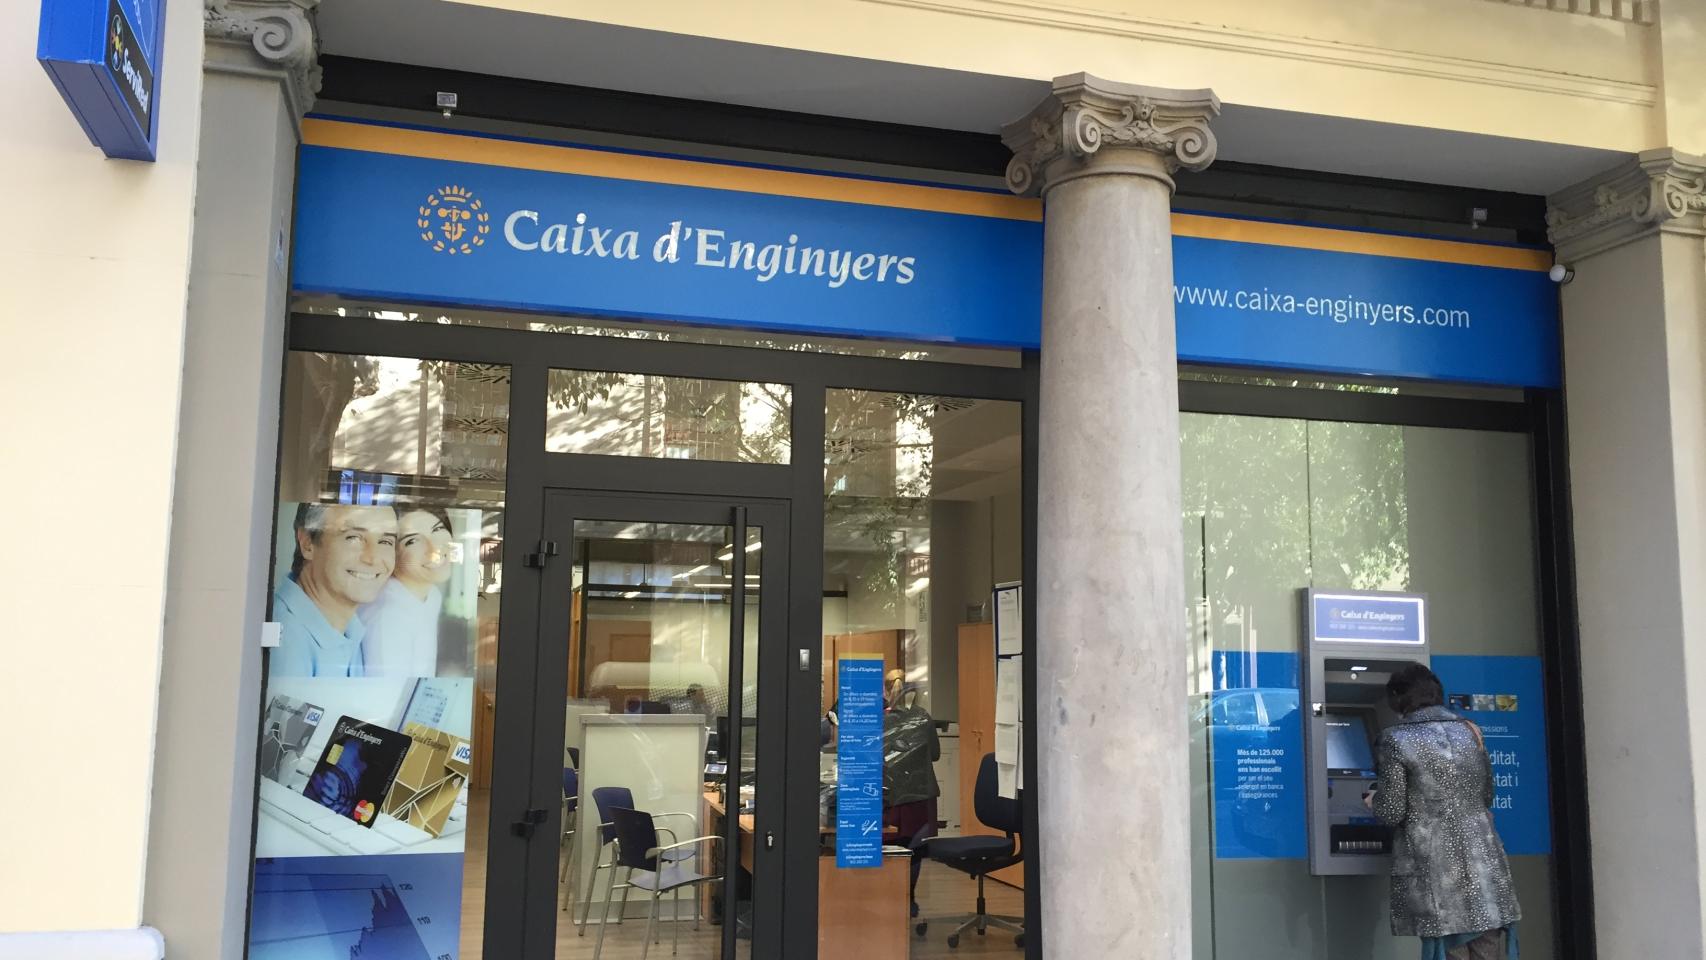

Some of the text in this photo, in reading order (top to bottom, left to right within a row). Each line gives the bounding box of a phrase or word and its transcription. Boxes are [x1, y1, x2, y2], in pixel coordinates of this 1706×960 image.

[503, 209, 915, 288] Caixa d'Enginyers
[306, 710, 321, 723] VISA
[1490, 794, 1512, 809] itat
